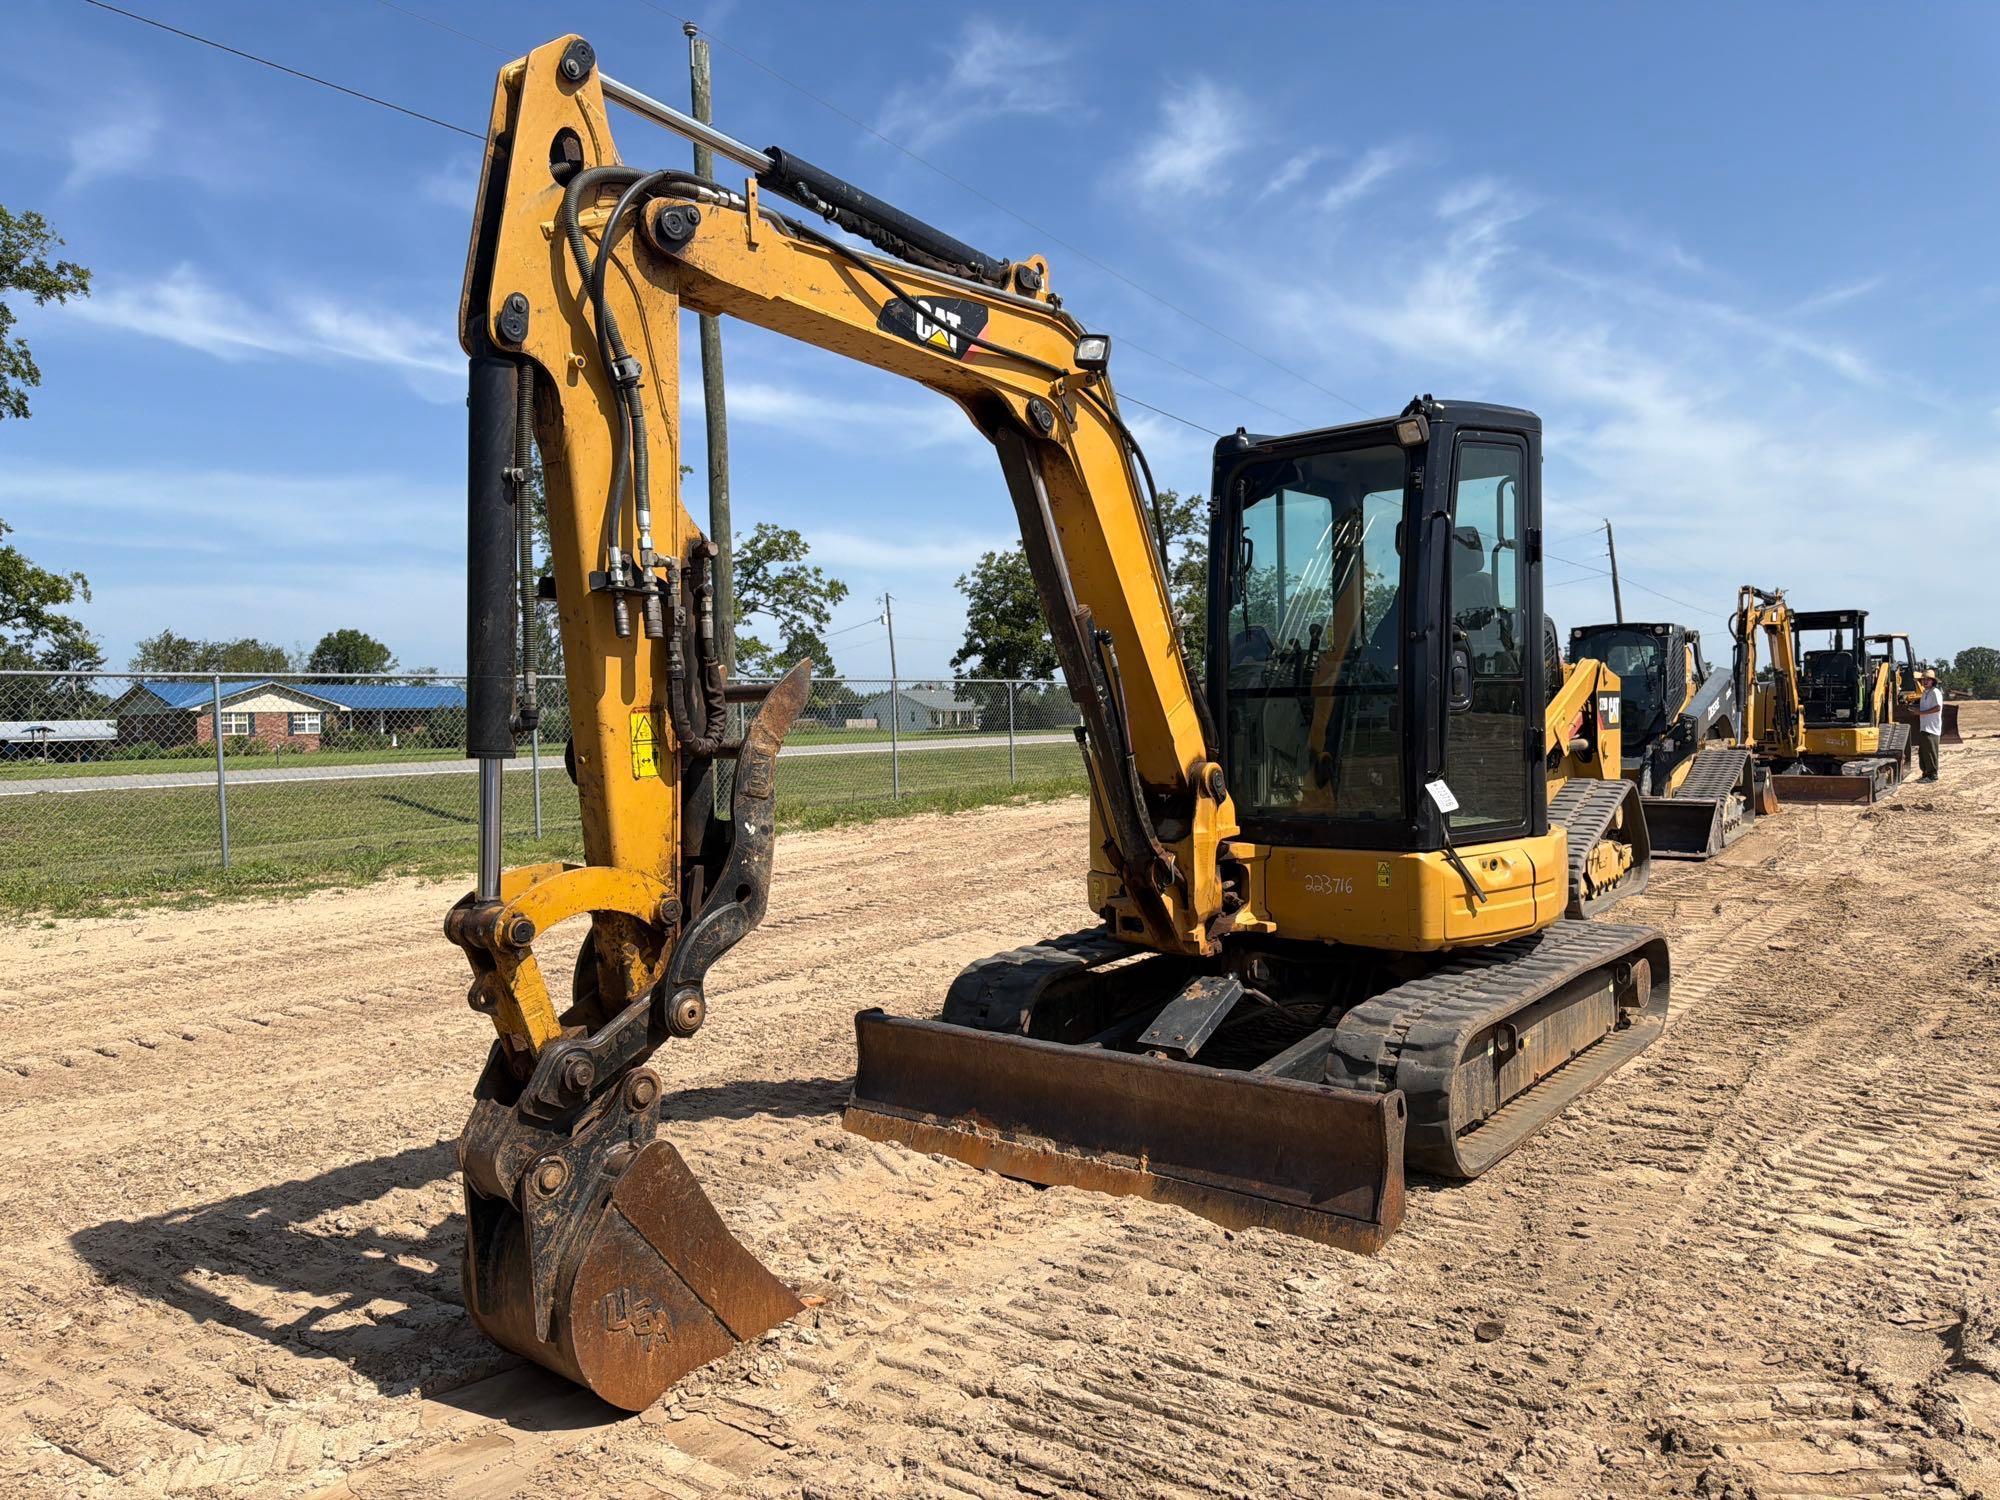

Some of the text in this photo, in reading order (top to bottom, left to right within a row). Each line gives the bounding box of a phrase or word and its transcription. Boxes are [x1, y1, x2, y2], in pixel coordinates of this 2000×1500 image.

[916, 300, 961, 353] CAT
[1608, 697, 1620, 723] CAT
[1304, 874, 1353, 895] 223716
